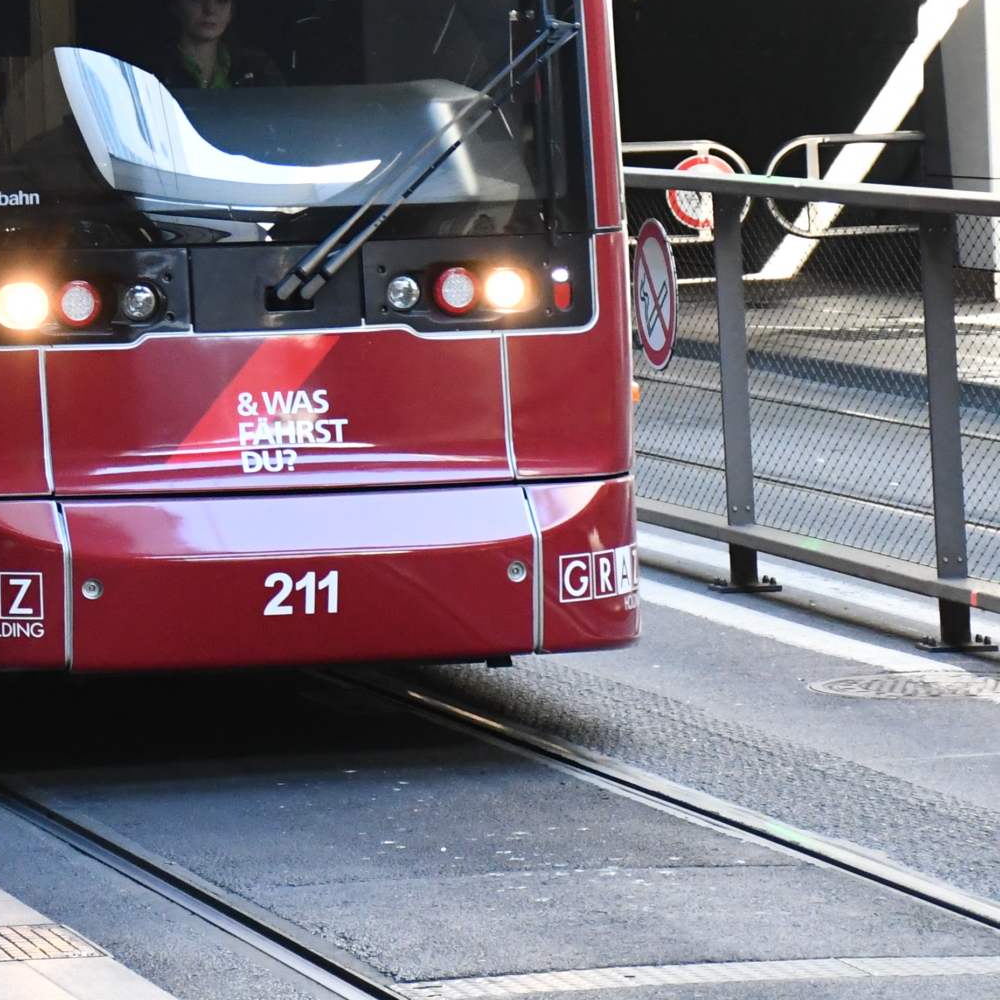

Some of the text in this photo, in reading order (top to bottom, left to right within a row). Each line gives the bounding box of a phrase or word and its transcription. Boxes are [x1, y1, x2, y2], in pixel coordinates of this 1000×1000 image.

[237, 389, 329, 417] & WAS
[238, 417, 348, 446] FÄHRST
[241, 449, 298, 473] DU?
[263, 570, 339, 616] 211
